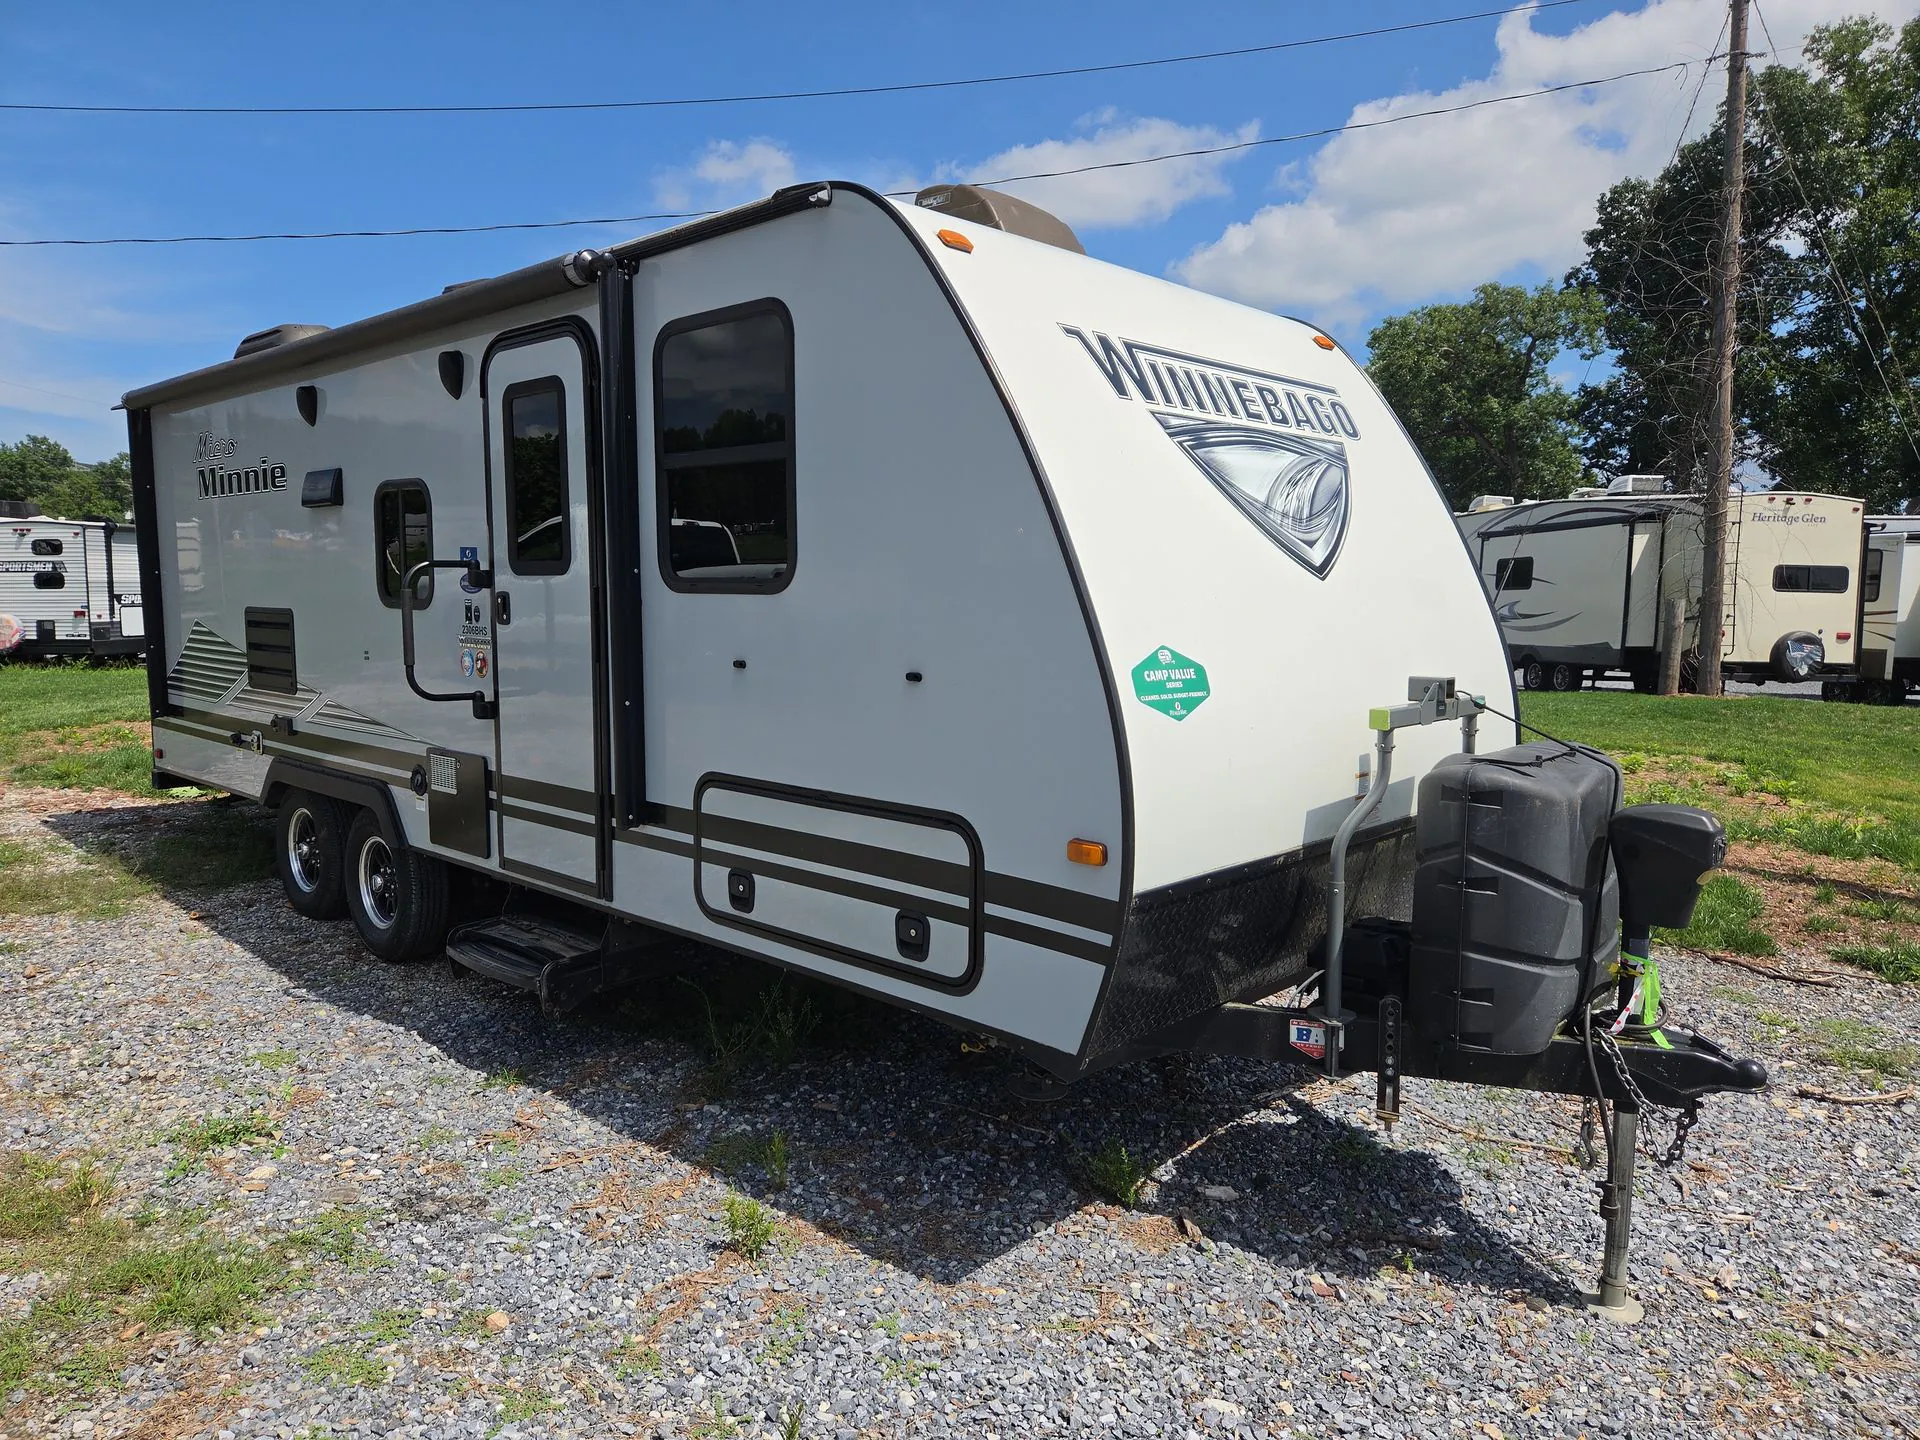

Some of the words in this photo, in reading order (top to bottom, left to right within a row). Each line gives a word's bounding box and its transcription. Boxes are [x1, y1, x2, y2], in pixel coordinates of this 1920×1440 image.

[1056, 321, 1361, 441] WINNEBAGO
[193, 431, 237, 463] Micro
[197, 456, 287, 500] Minnie
[1752, 512, 1800, 525] Heritage
[1802, 513, 1826, 523] Glen
[1144, 670, 1168, 681] CAMP
[1169, 668, 1196, 679] VALUE
